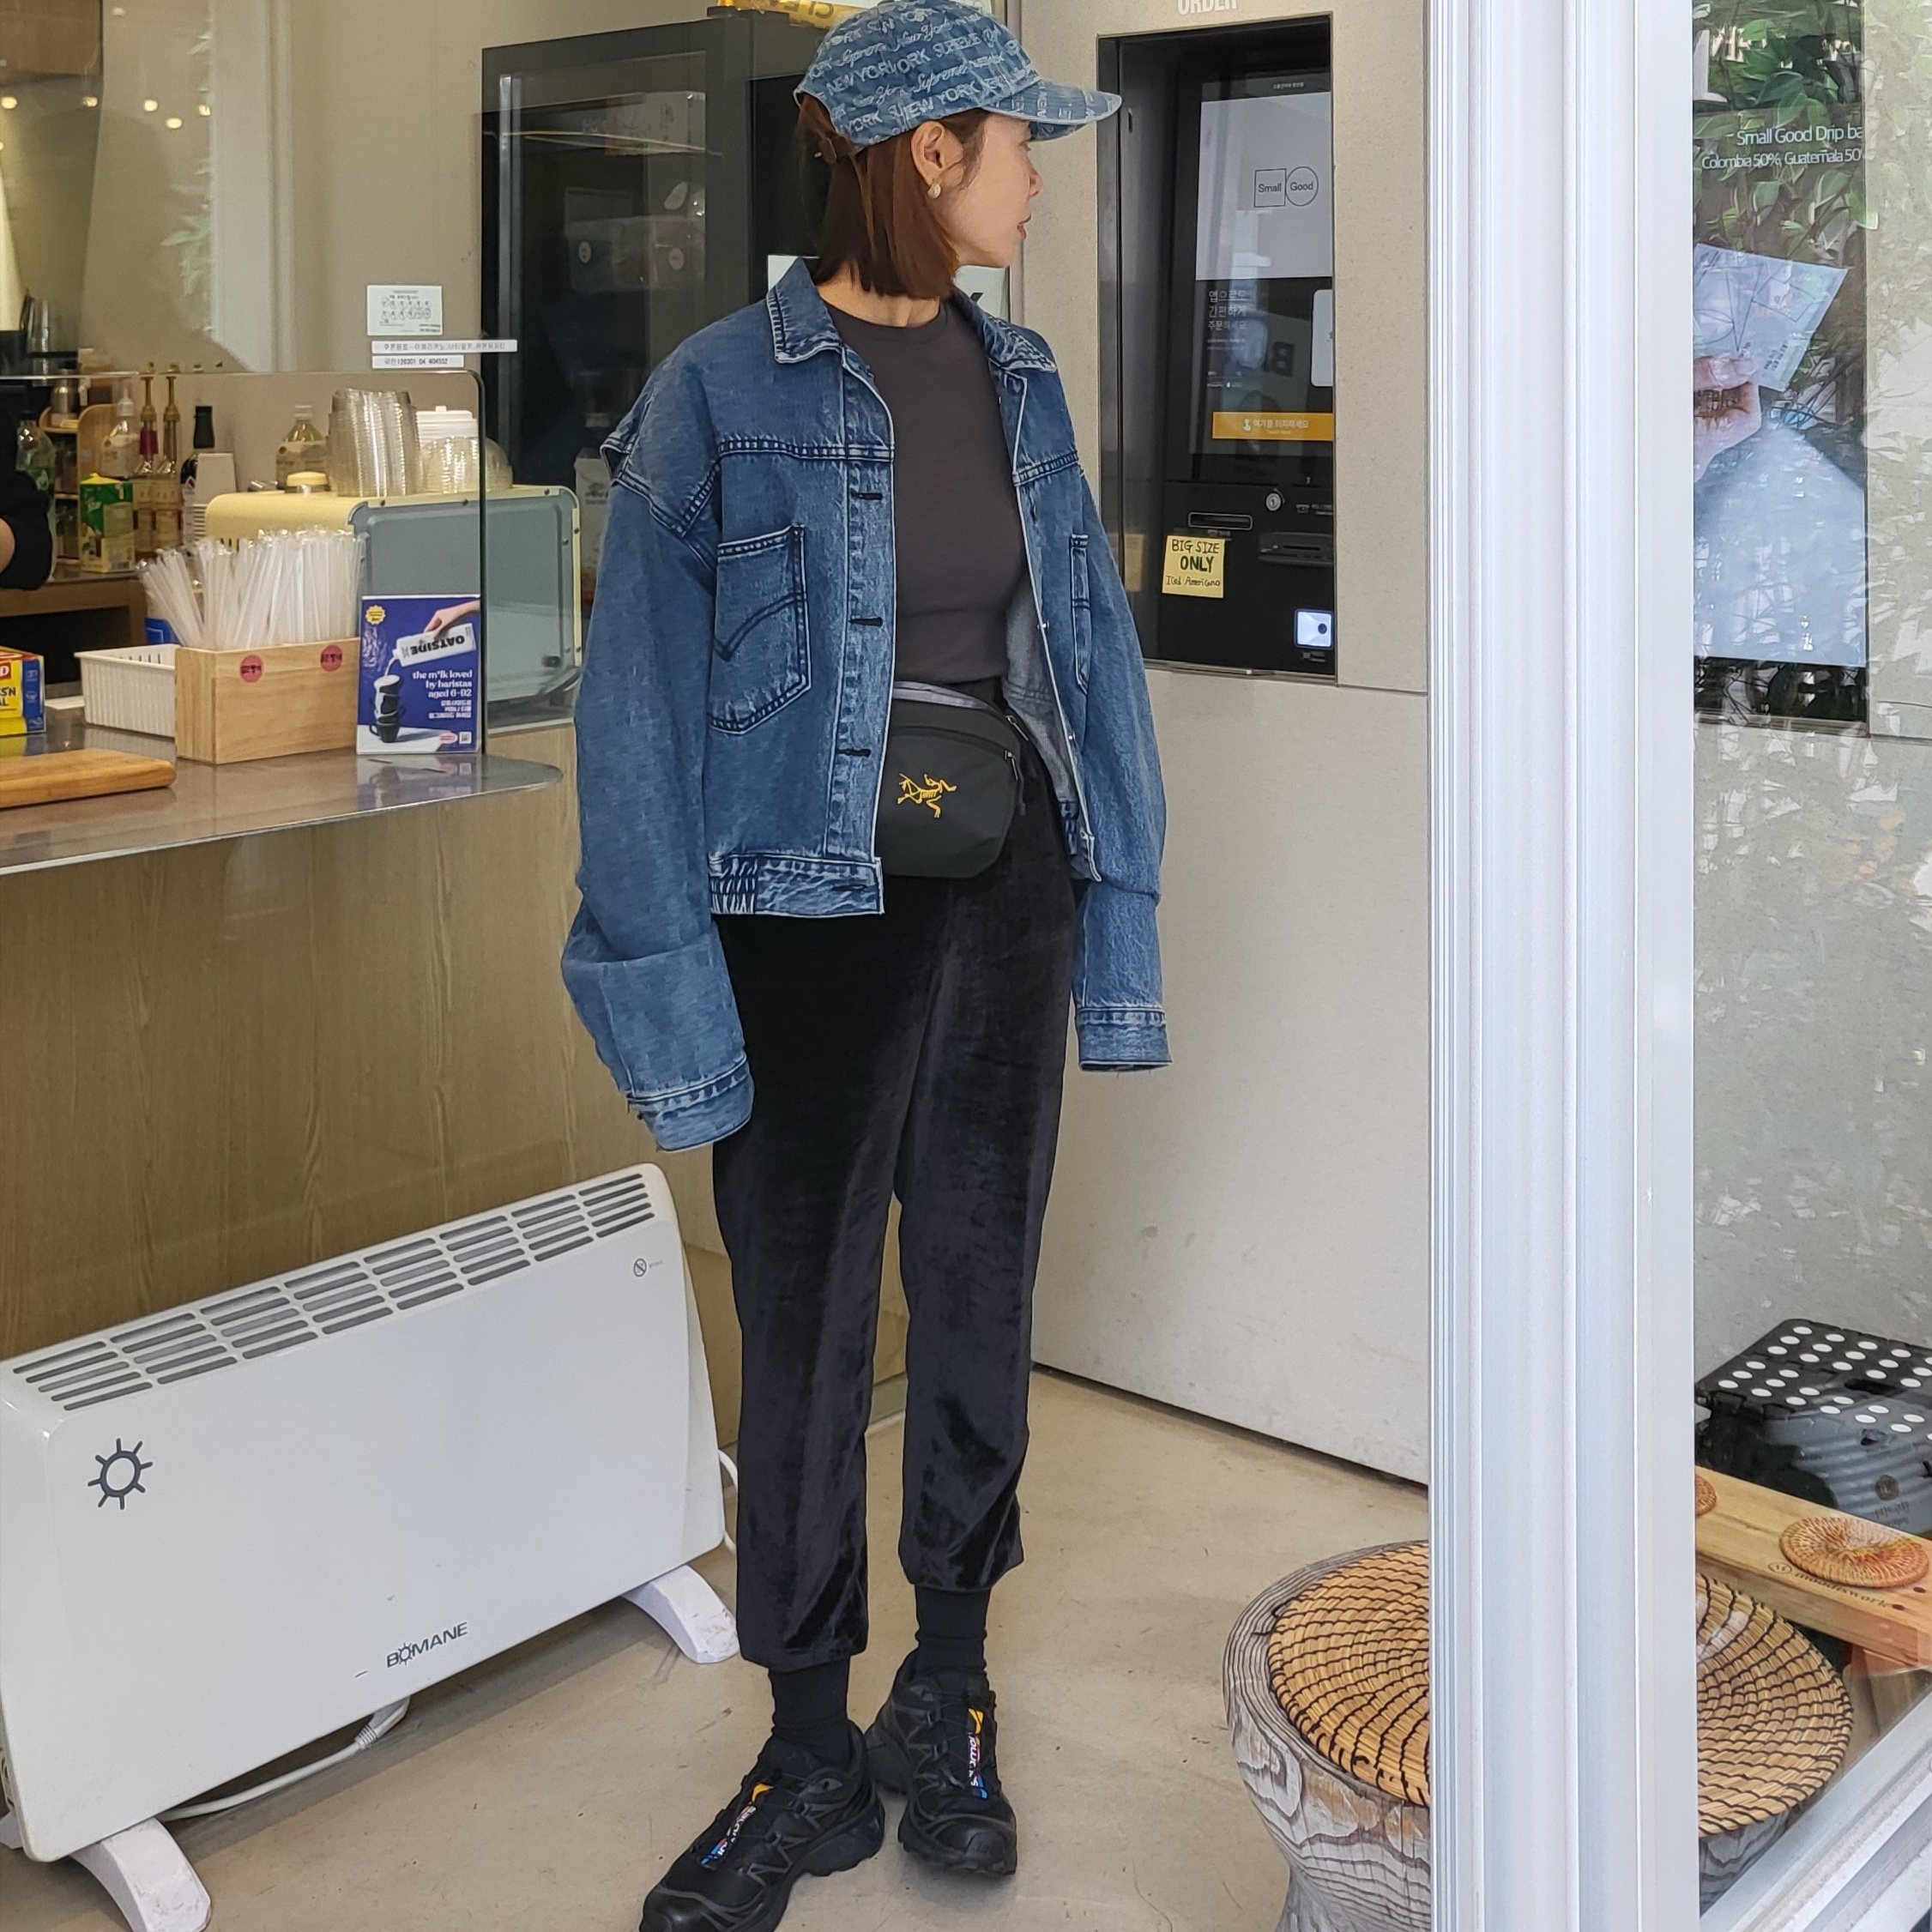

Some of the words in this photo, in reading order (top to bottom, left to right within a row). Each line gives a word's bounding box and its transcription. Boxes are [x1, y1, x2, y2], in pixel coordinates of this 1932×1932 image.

[1736, 128, 1772, 146] Small
[1774, 125, 1813, 144] Good
[1815, 124, 1844, 142] Drip
[1844, 148, 1863, 162] 50
[1258, 182, 1283, 193] Small
[1289, 180, 1314, 191] Good
[1171, 539, 1194, 554] BIG
[1195, 540, 1220, 554] SIZE
[1180, 555, 1215, 574] ONLY
[409, 635, 465, 655] OATSIDE
[413, 670, 427, 679] the
[450, 669, 473, 679] loved
[426, 679, 437, 690] by
[438, 679, 473, 689] baristas
[428, 689, 449, 699] aged
[386, 1621, 468, 1669] BOMANE
